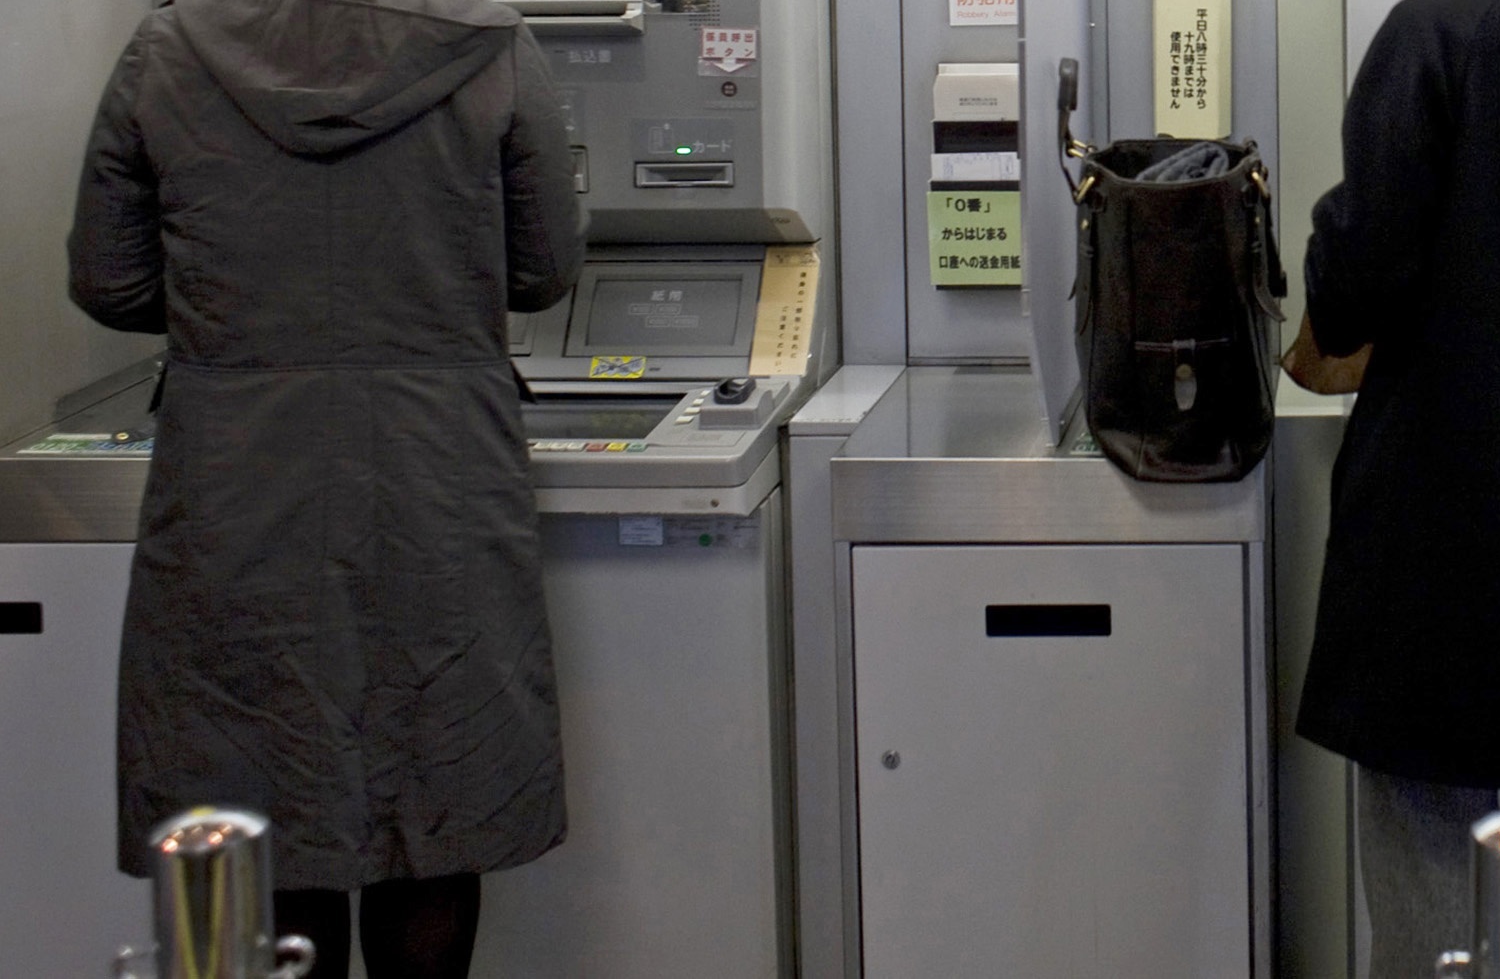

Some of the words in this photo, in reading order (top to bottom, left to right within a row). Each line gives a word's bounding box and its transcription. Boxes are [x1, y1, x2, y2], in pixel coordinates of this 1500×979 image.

[706, 47, 753, 57] ボタン
[1196, 8, 1208, 109] 平日八時三十分から
[1170, 31, 1182, 110] 使用できません
[1183, 31, 1195, 98] 十九時までは
[692, 139, 733, 153] カード
[942, 227, 1007, 240] からはじまる
[939, 255, 1021, 269] 口座への送金用紙
